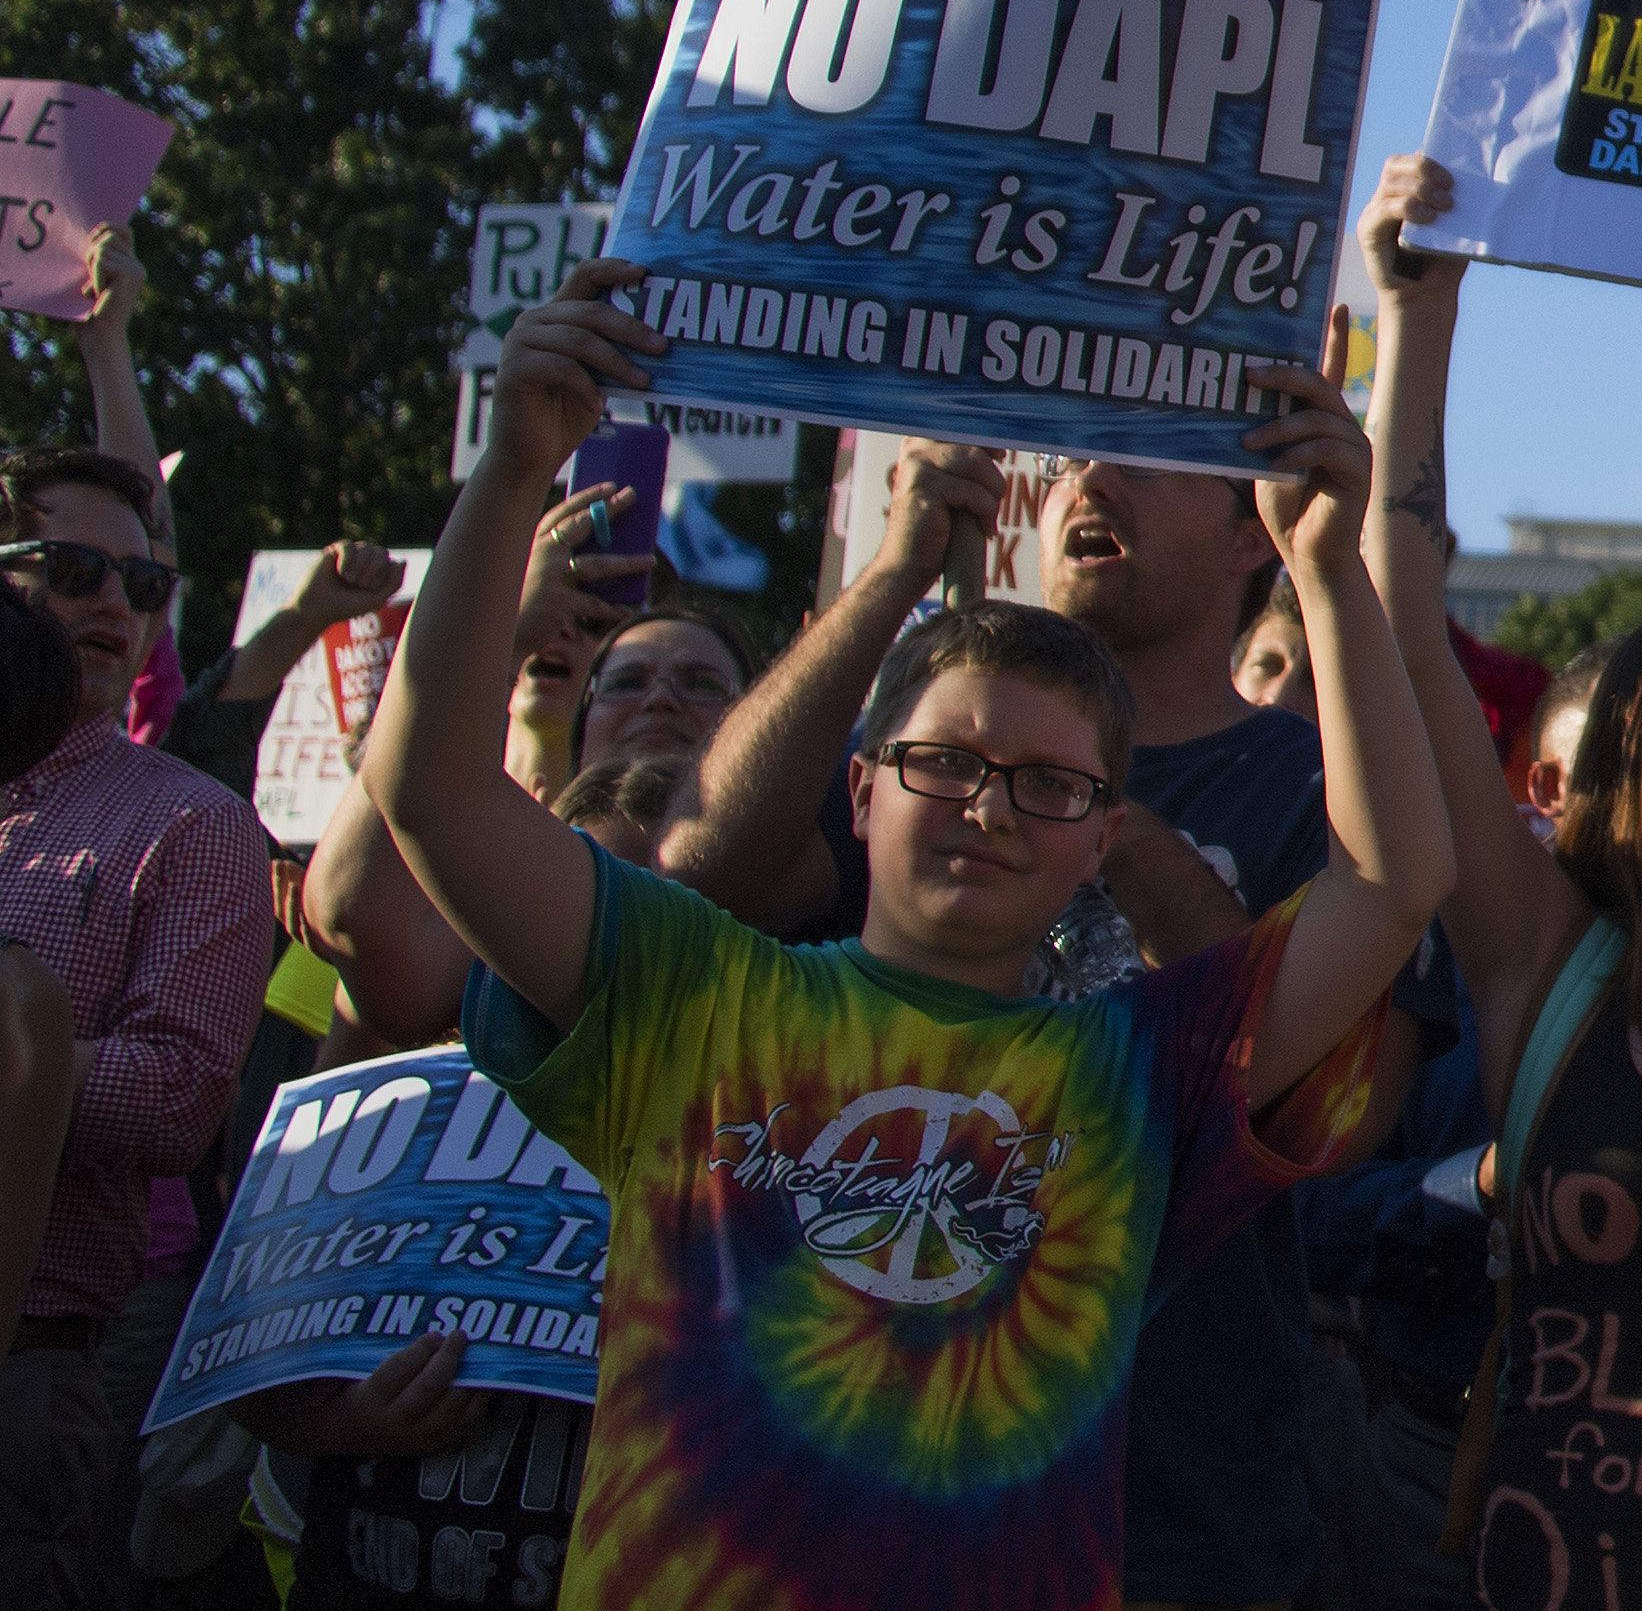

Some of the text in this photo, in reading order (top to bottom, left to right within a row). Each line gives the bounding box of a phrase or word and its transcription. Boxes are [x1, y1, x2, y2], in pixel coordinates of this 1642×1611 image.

[650, 142, 1319, 326] Water is Life!
[901, 307, 969, 375] IN
[250, 1076, 432, 1218] NO
[220, 1217, 431, 1303] Water
[440, 1206, 518, 1267] is
[1523, 1166, 1642, 1274] NO
[181, 1295, 366, 1381] STANDING
[366, 1295, 426, 1336] IN
[430, 1524, 507, 1605] OF
